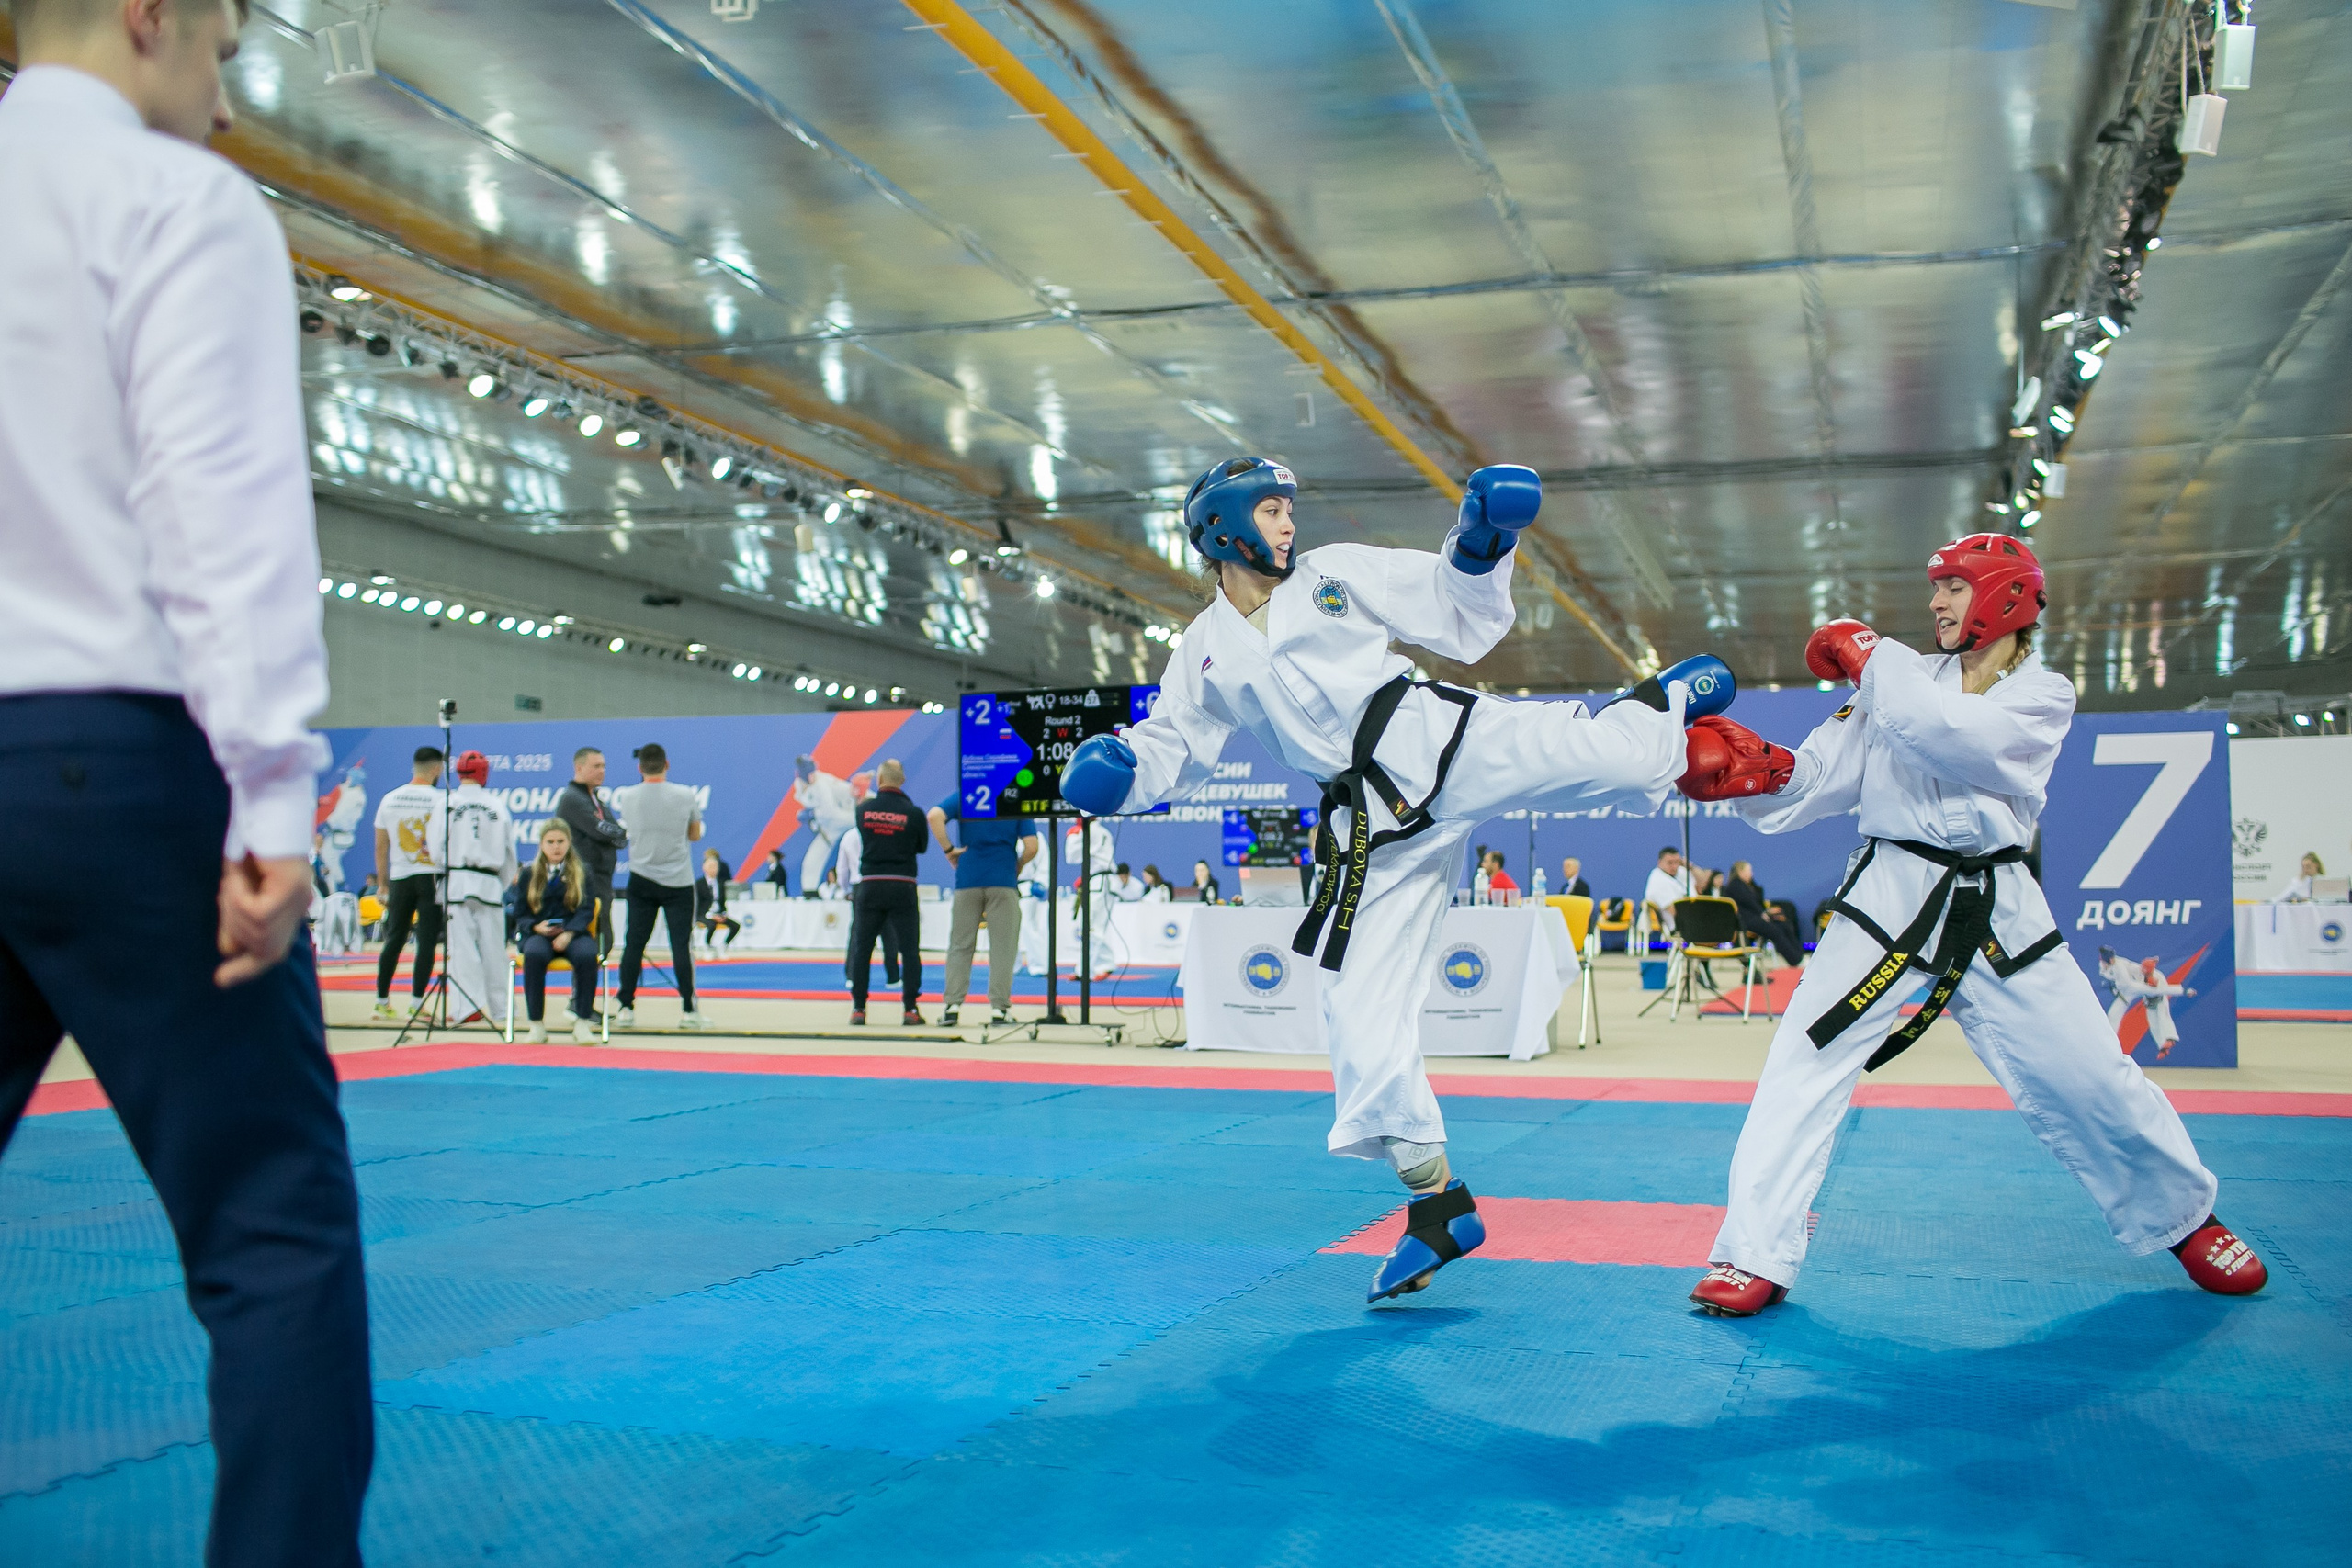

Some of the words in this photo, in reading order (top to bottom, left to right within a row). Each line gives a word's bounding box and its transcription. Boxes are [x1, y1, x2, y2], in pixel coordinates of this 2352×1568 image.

[1857, 634, 1873, 645] TOP
[965, 699, 991, 725] +2
[1059, 695, 1083, 705] 18-34
[1045, 716, 1074, 726] Round
[1074, 716, 1081, 726] 2
[1043, 728, 1050, 739] 2
[1057, 728, 1069, 738] W
[1076, 727, 1083, 738] 2
[514, 753, 552, 771] 2025
[1036, 742, 1074, 761] 1:08
[965, 785, 991, 811] +2
[1004, 788, 1018, 798] R2
[1190, 783, 1288, 804] ДЕВУШЕК
[2079, 731, 2214, 889] 7
[1350, 809, 1367, 888] DUBOVA
[1344, 892, 1358, 906] S.
[2076, 899, 2202, 931] ДОЯНГ
[1849, 952, 1909, 1010] RUSSIA
[1947, 967, 1962, 982] ITF
[2215, 1249, 2236, 1270] TOP
[2230, 1250, 2254, 1273] FIGHT
